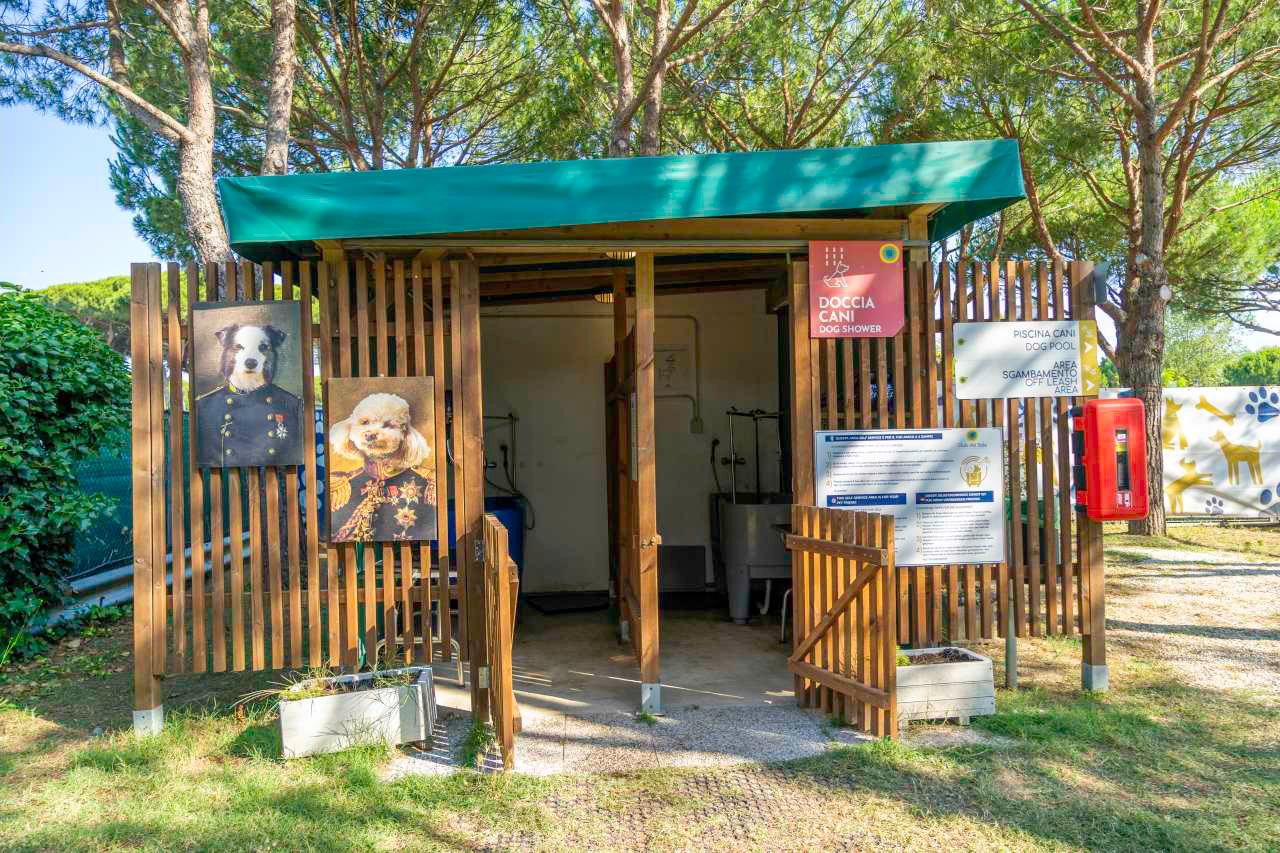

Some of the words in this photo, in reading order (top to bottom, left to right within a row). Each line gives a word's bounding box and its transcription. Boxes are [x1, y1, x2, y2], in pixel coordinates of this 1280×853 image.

[818, 296, 876, 309] DOCCIA
[818, 310, 855, 322] CANI
[819, 325, 840, 333] DOG
[842, 324, 882, 333] SHOWER
[1013, 329, 1051, 339] PISCINA
[1053, 329, 1076, 338] CANI
[1025, 342, 1047, 351] DOG
[1049, 341, 1077, 351] POOL
[1053, 360, 1078, 369] AREA
[1002, 369, 1078, 379] SGAMBAMENTO
[1025, 378, 1044, 386] OFF
[1046, 377, 1078, 386] LEASH
[1054, 385, 1079, 394] AREA
